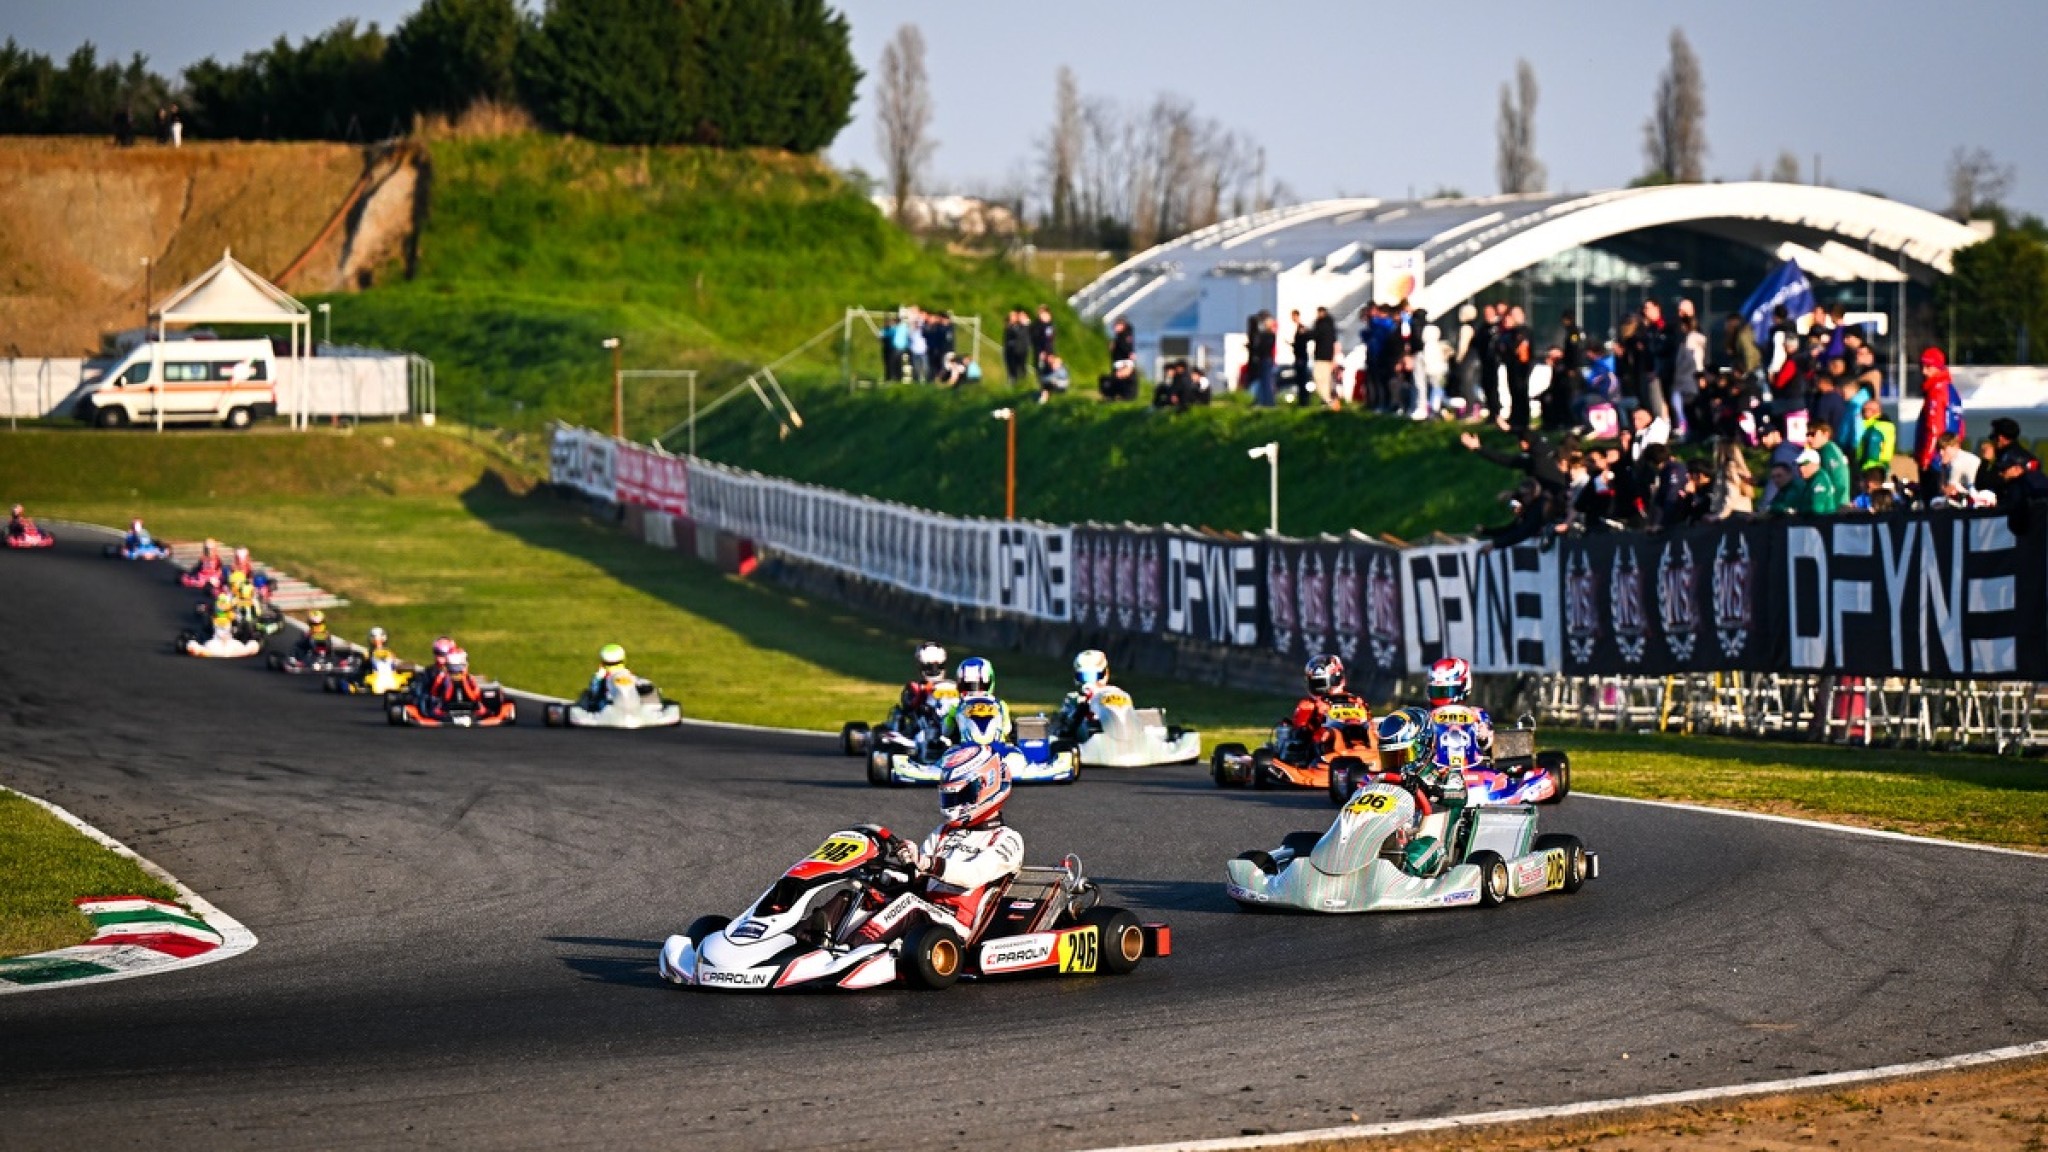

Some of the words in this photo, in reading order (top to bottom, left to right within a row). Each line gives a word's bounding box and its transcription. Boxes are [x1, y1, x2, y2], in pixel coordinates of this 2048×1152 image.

[1000, 528, 1067, 617] DFYNE
[1168, 538, 1257, 645] DFYNE
[1410, 547, 1545, 668] DFYNE
[1787, 516, 2018, 674] DFYNE
[1066, 931, 1097, 972] 246
